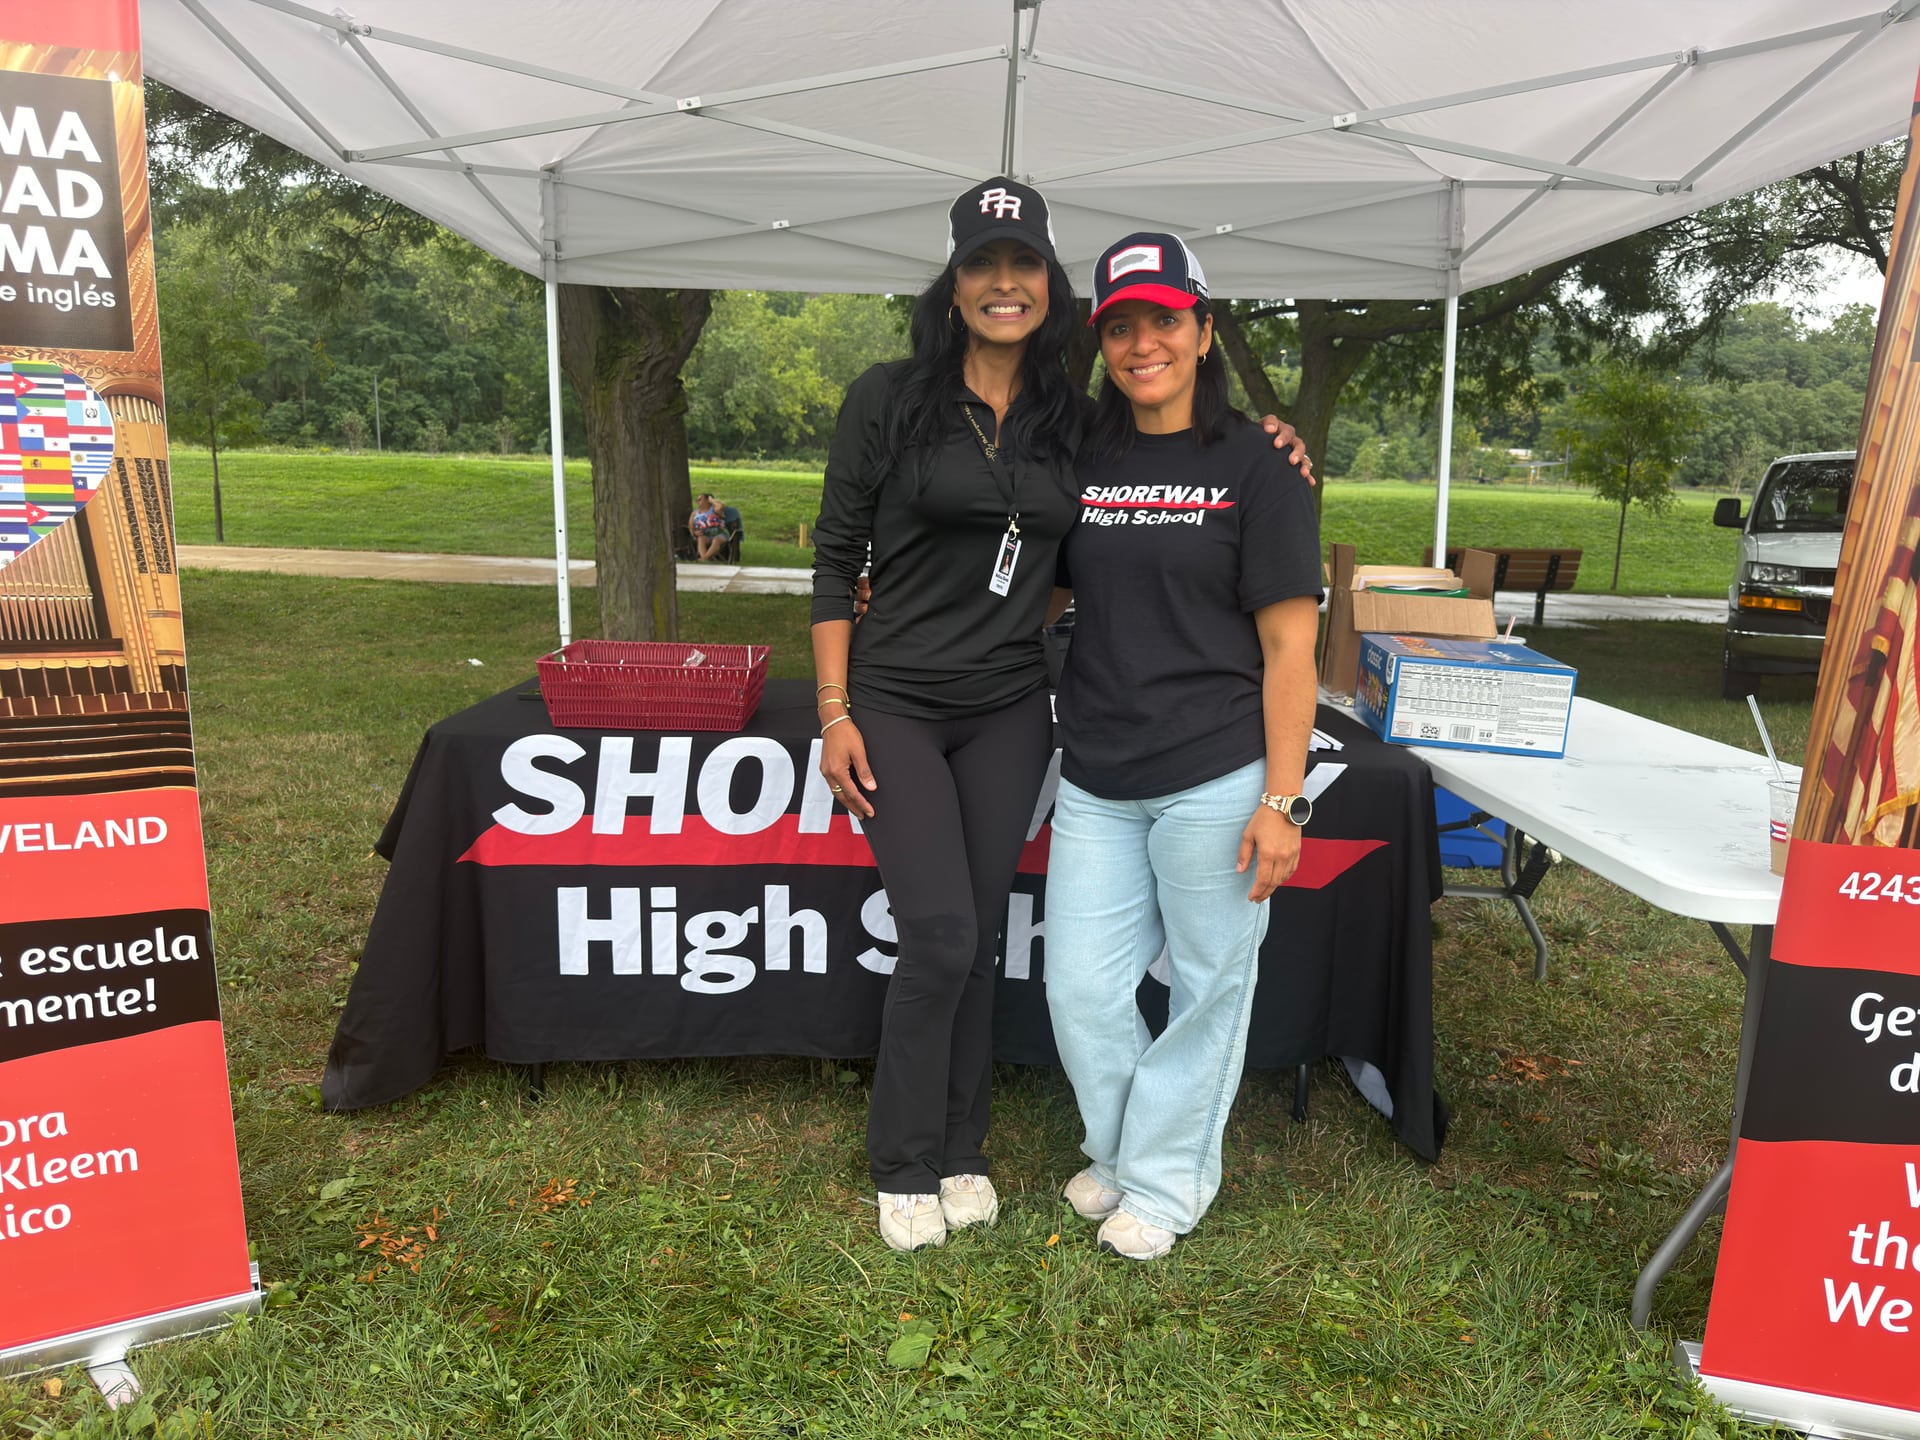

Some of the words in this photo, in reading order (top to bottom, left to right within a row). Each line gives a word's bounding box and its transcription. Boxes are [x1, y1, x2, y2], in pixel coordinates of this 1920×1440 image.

[0, 106, 102, 163] MA
[0, 165, 104, 219] AD
[979, 187, 1022, 220] PR
[0, 223, 112, 279] MA
[26, 281, 116, 312] inglés
[1081, 484, 1229, 506] SHOREWAY
[1081, 507, 1128, 526] High
[1131, 508, 1205, 526] School
[1839, 872, 1920, 904] 4243
[20, 927, 200, 976] escuela
[557, 884, 828, 994] High
[0, 978, 157, 1027] mente!
[1850, 992, 1920, 1044] Ge
[0, 1147, 139, 1194] Kleem
[0, 1203, 72, 1240] ico
[1824, 1278, 1913, 1333] We
